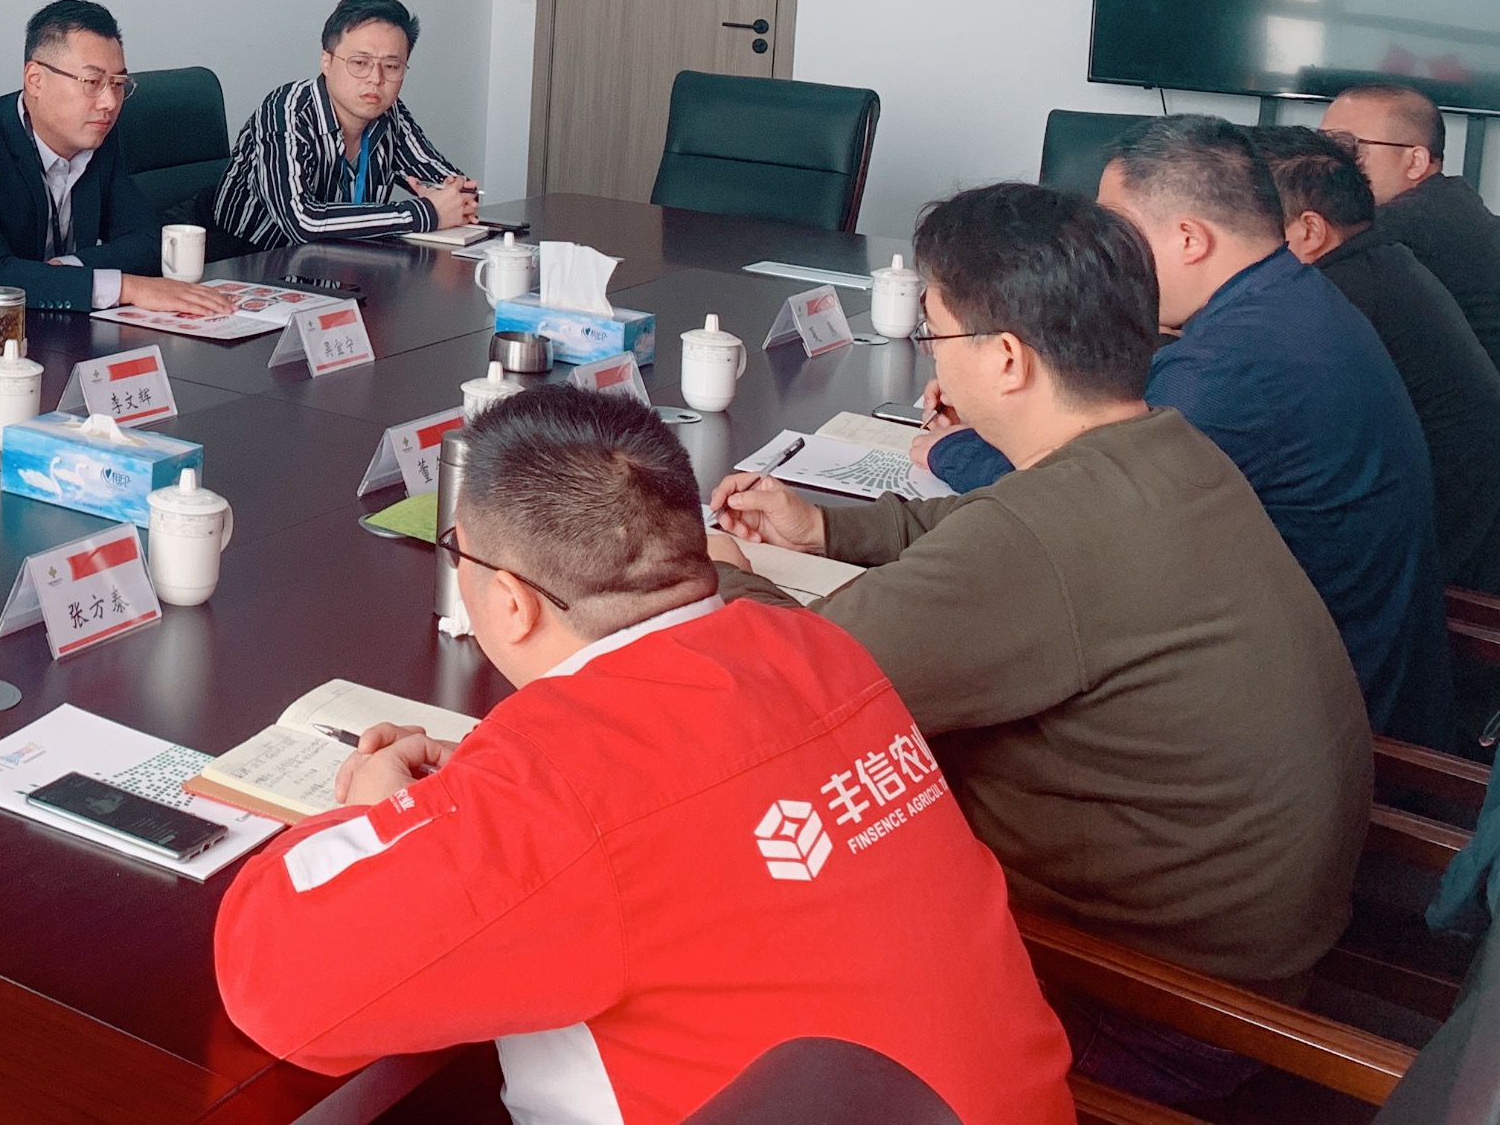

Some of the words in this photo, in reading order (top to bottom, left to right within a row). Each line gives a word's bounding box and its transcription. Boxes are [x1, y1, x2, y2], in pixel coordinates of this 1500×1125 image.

[111, 388, 152, 415] 李文辉
[846, 808, 908, 855] FINSENCE
